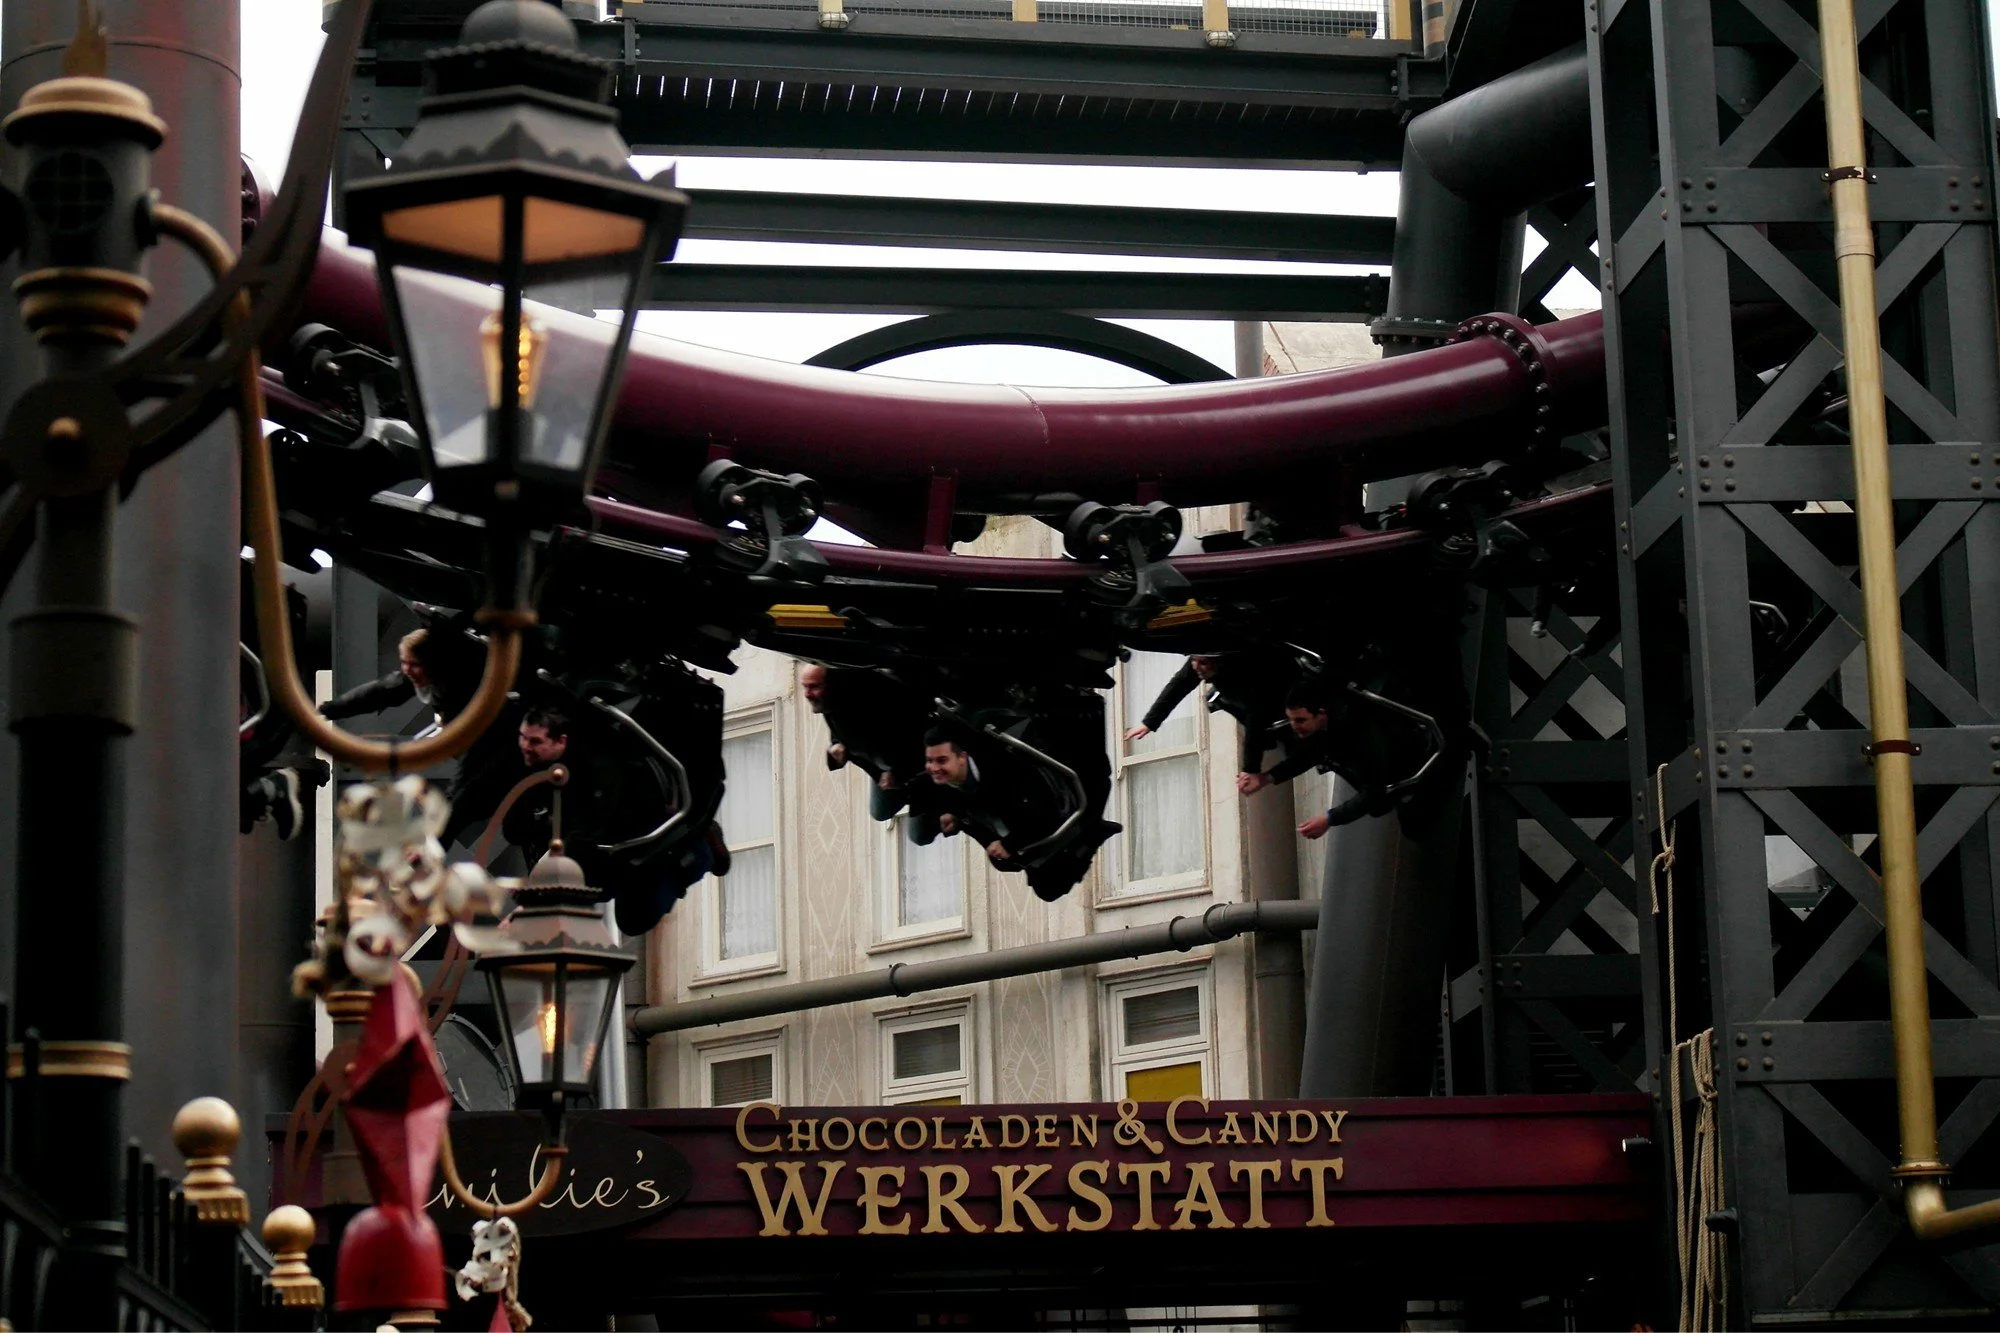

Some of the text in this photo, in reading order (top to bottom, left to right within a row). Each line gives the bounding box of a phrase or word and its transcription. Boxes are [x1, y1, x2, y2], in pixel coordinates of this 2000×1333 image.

[735, 1093, 1349, 1155] CHOCOLADEN & CANDY
[736, 1156, 1344, 1236] WERKSTATT
